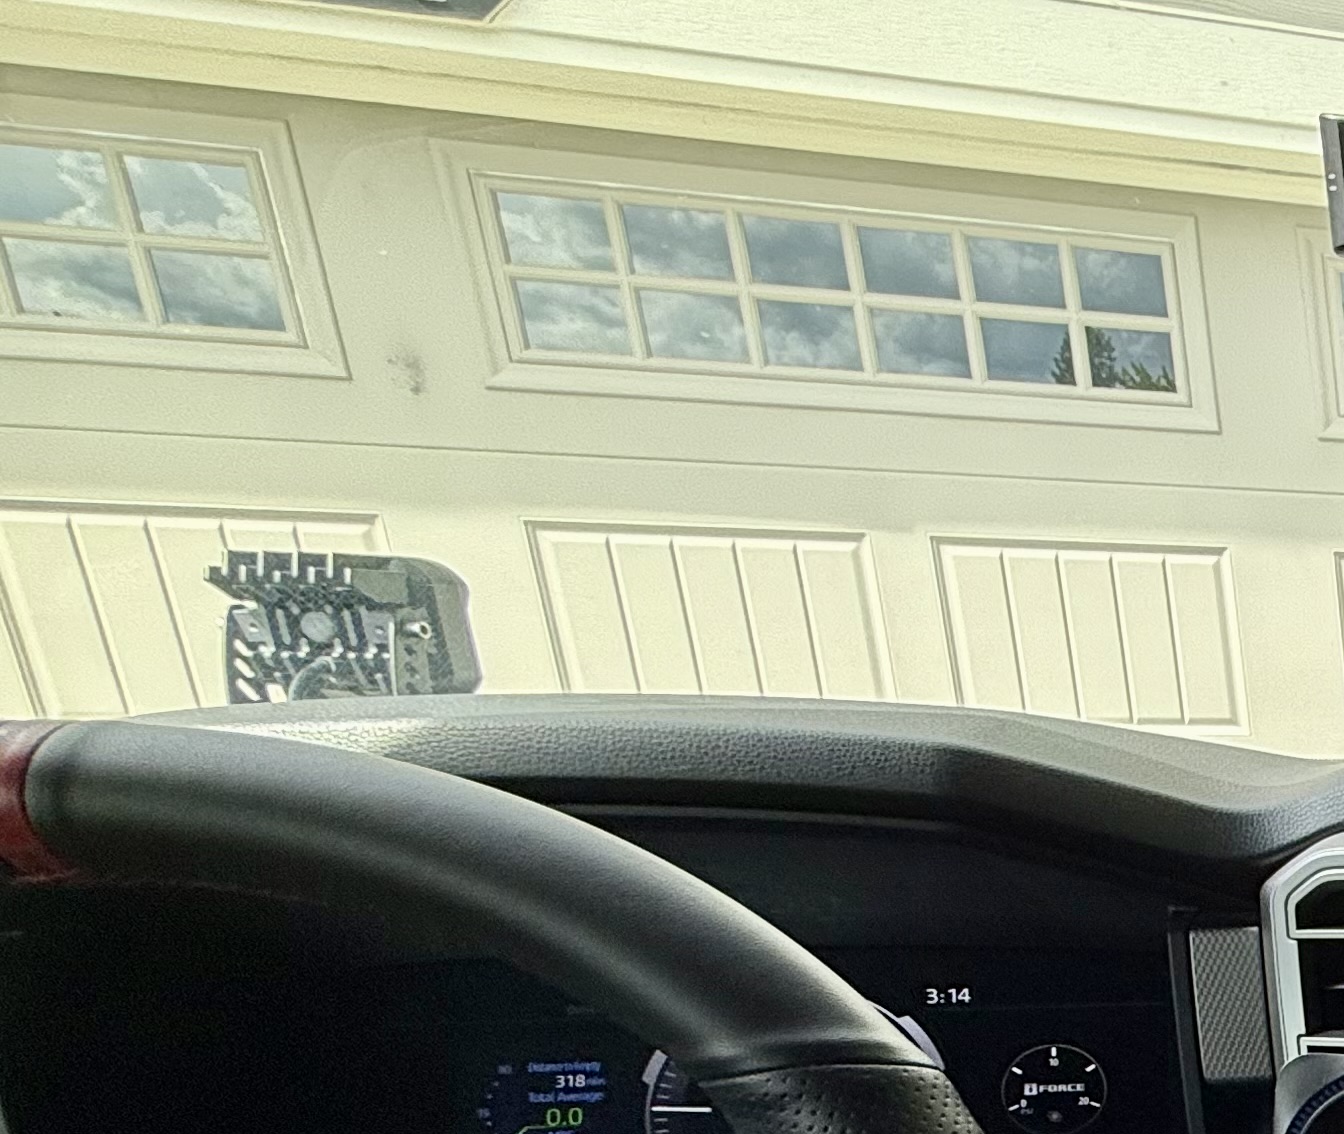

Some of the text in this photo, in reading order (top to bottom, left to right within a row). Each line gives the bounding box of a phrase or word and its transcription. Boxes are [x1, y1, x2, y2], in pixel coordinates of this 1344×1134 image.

[926, 988, 971, 1004] 3:14
[1048, 1058, 1060, 1067] 10
[555, 1073, 586, 1088] 318
[546, 1107, 583, 1127] 0.0
